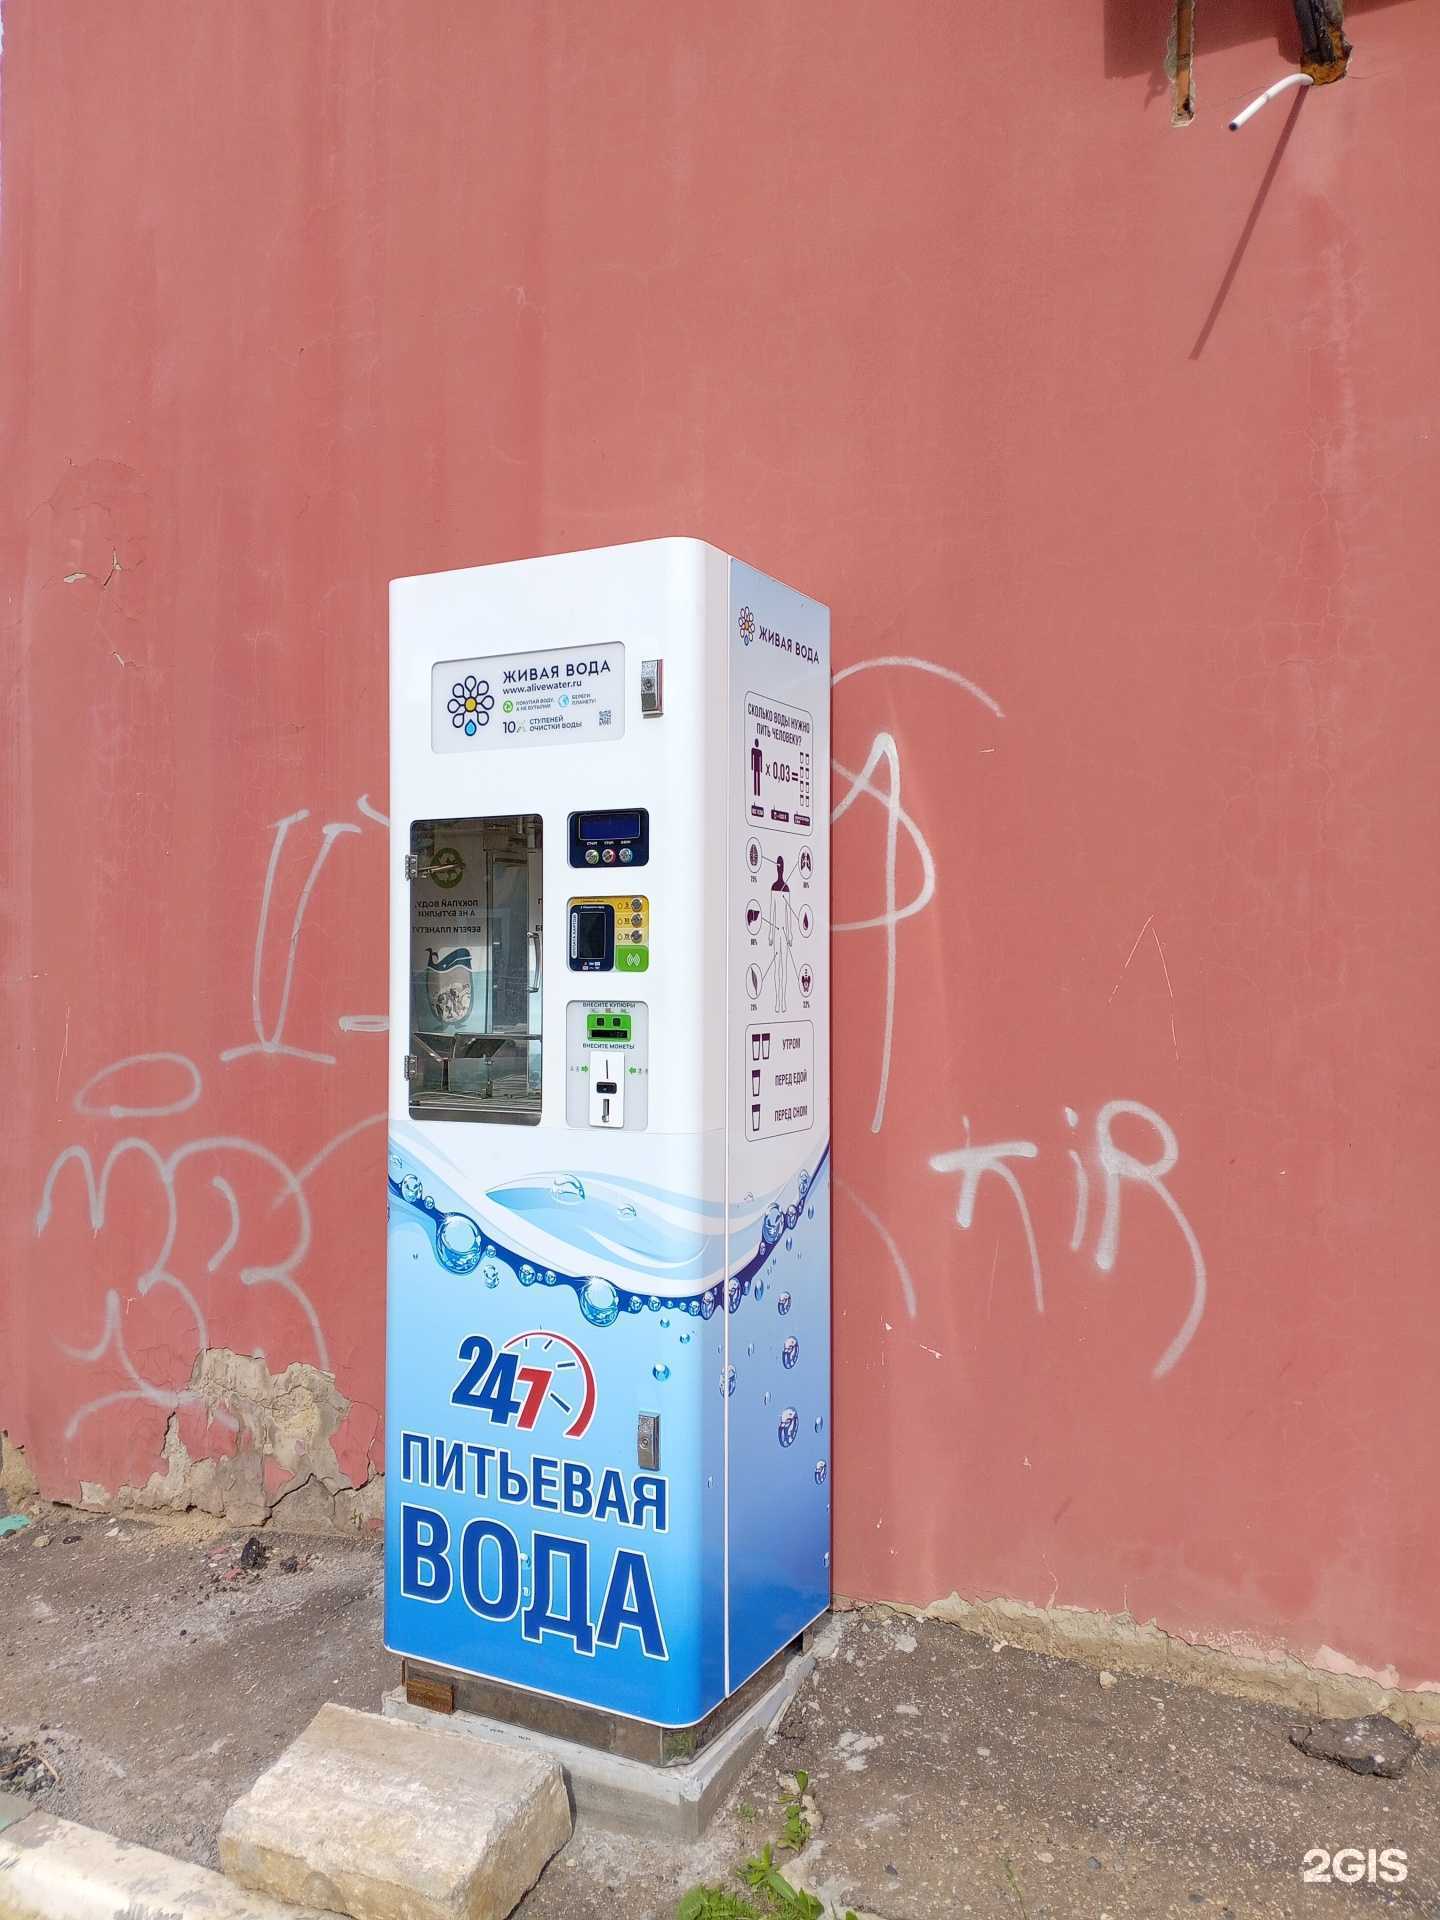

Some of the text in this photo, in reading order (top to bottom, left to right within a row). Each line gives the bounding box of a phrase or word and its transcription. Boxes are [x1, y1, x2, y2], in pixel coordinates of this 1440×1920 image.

[759, 625, 820, 665] ЖИВАЯ ВОДА
[503, 660, 611, 684] ЖИВАЯ ВОДА
[502, 680, 582, 695] www.alivewater.ru
[502, 720, 516, 734] 10
[529, 715, 564, 725] СТУПЕНЕЙ
[529, 721, 583, 732] ОЧИСТКИ ВОДЫ
[747, 703, 810, 734] СКОЛЬКО ВОДЫ НУЖНО
[756, 722, 802, 747] ПИТЬ ЧЕЛОВЕКУ?
[782, 1037, 801, 1050] УТРОМ
[774, 1068, 808, 1086] ПЕРЕД ЕДОЙ
[774, 1105, 808, 1121] ПЕРЕД СНОМ
[401, 1431, 669, 1534] ПИТЬЕВАЯ
[401, 1502, 669, 1661] ВОДА
